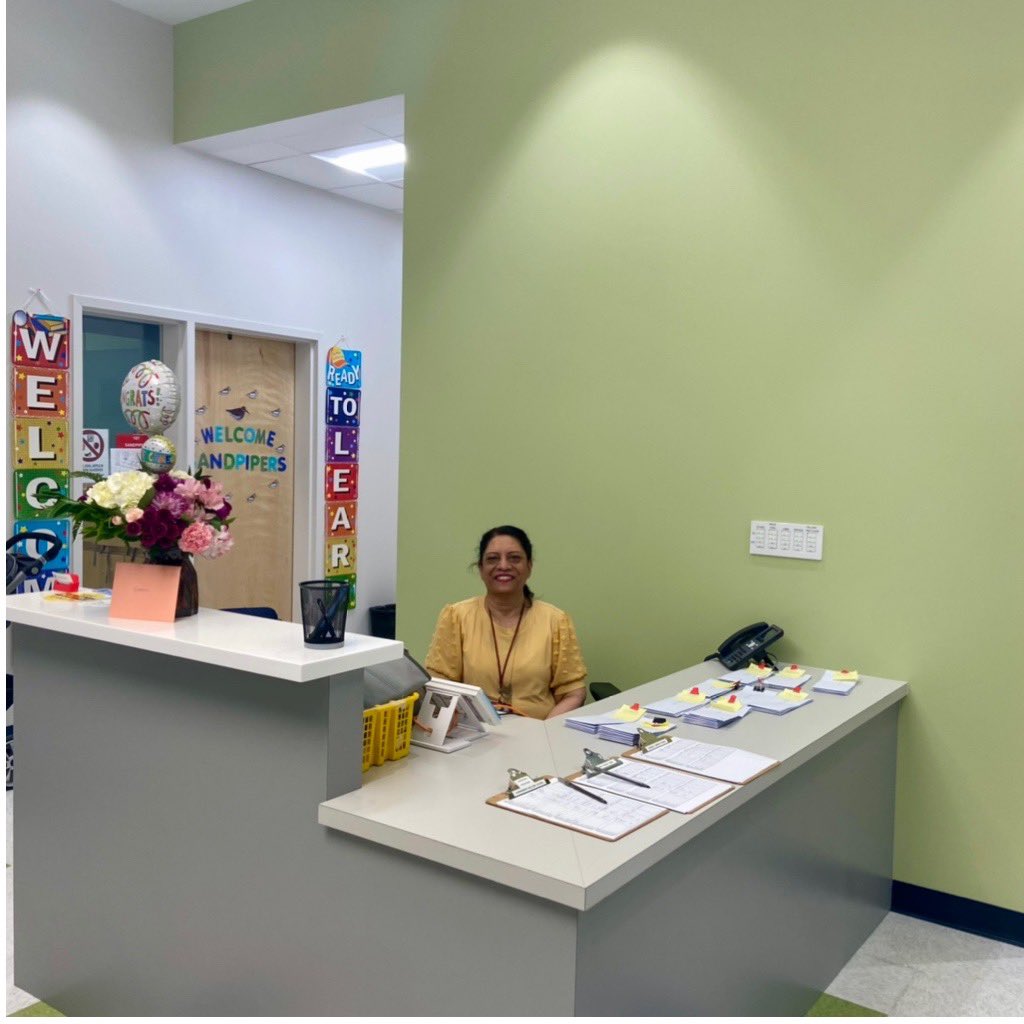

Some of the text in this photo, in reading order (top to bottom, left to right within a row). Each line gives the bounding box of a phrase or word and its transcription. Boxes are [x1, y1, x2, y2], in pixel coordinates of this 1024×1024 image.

[327, 364, 360, 386] READY
[330, 396, 357, 417] TO
[200, 425, 276, 448] WELCOME
[197, 452, 287, 472] ANDPIPERS
[331, 431, 351, 585] LEAR
